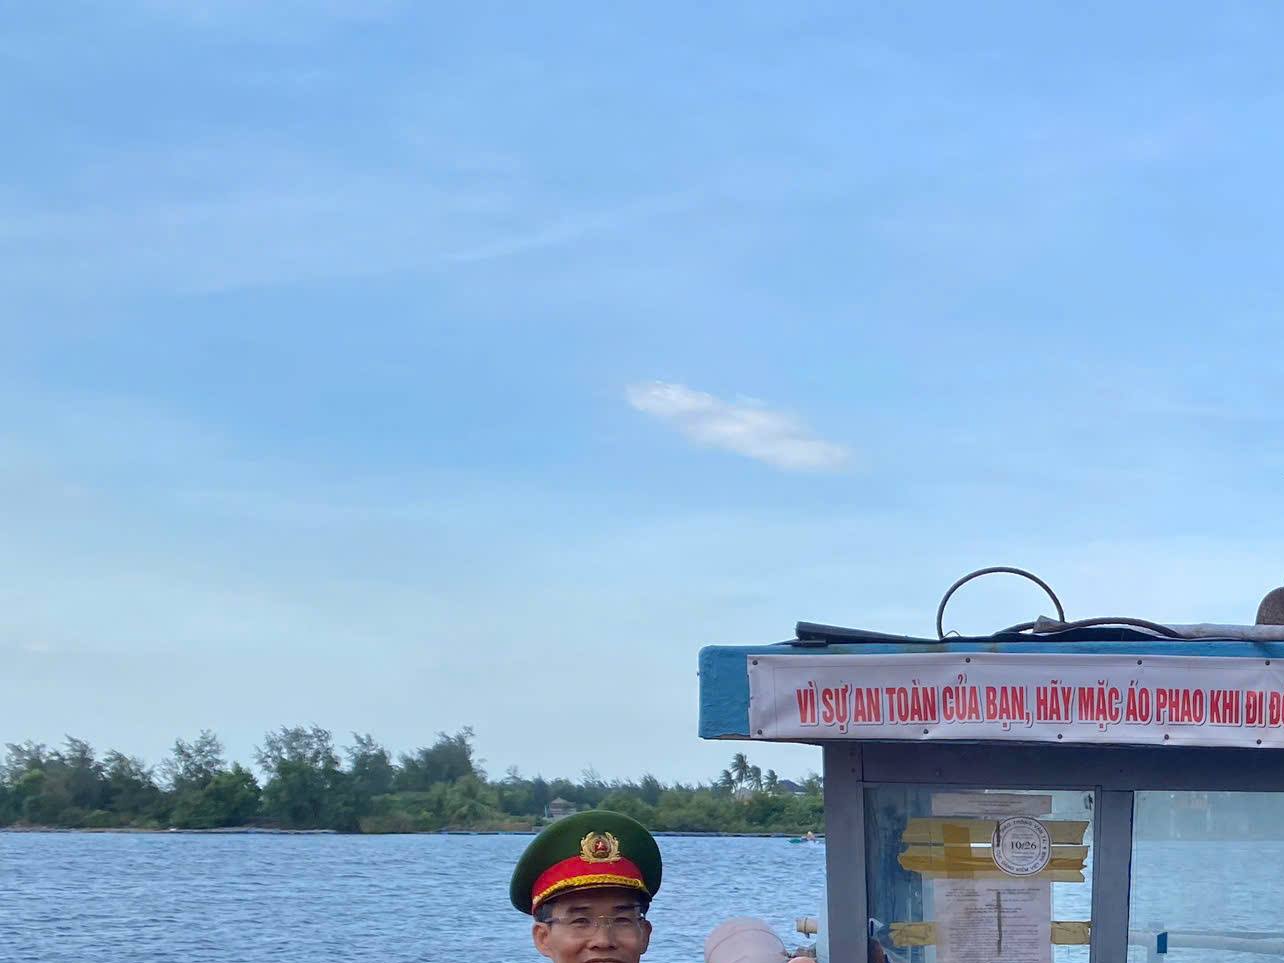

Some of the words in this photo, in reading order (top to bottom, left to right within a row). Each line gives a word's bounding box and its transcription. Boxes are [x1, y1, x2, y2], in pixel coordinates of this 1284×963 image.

[796, 680, 816, 723] VÌ
[821, 684, 849, 731] SỰ
[854, 687, 881, 722] AN
[885, 678, 937, 722] TOÀN
[942, 673, 980, 721] CỦA
[986, 686, 1031, 728] BẠN,
[1036, 680, 1072, 721] HÃY
[1078, 679, 1120, 729] MẶC
[1125, 680, 1150, 722] ÁO
[1155, 688, 1204, 723] PHAO
[1209, 689, 1240, 724] KHI
[1245, 690, 1264, 725] ĐI
